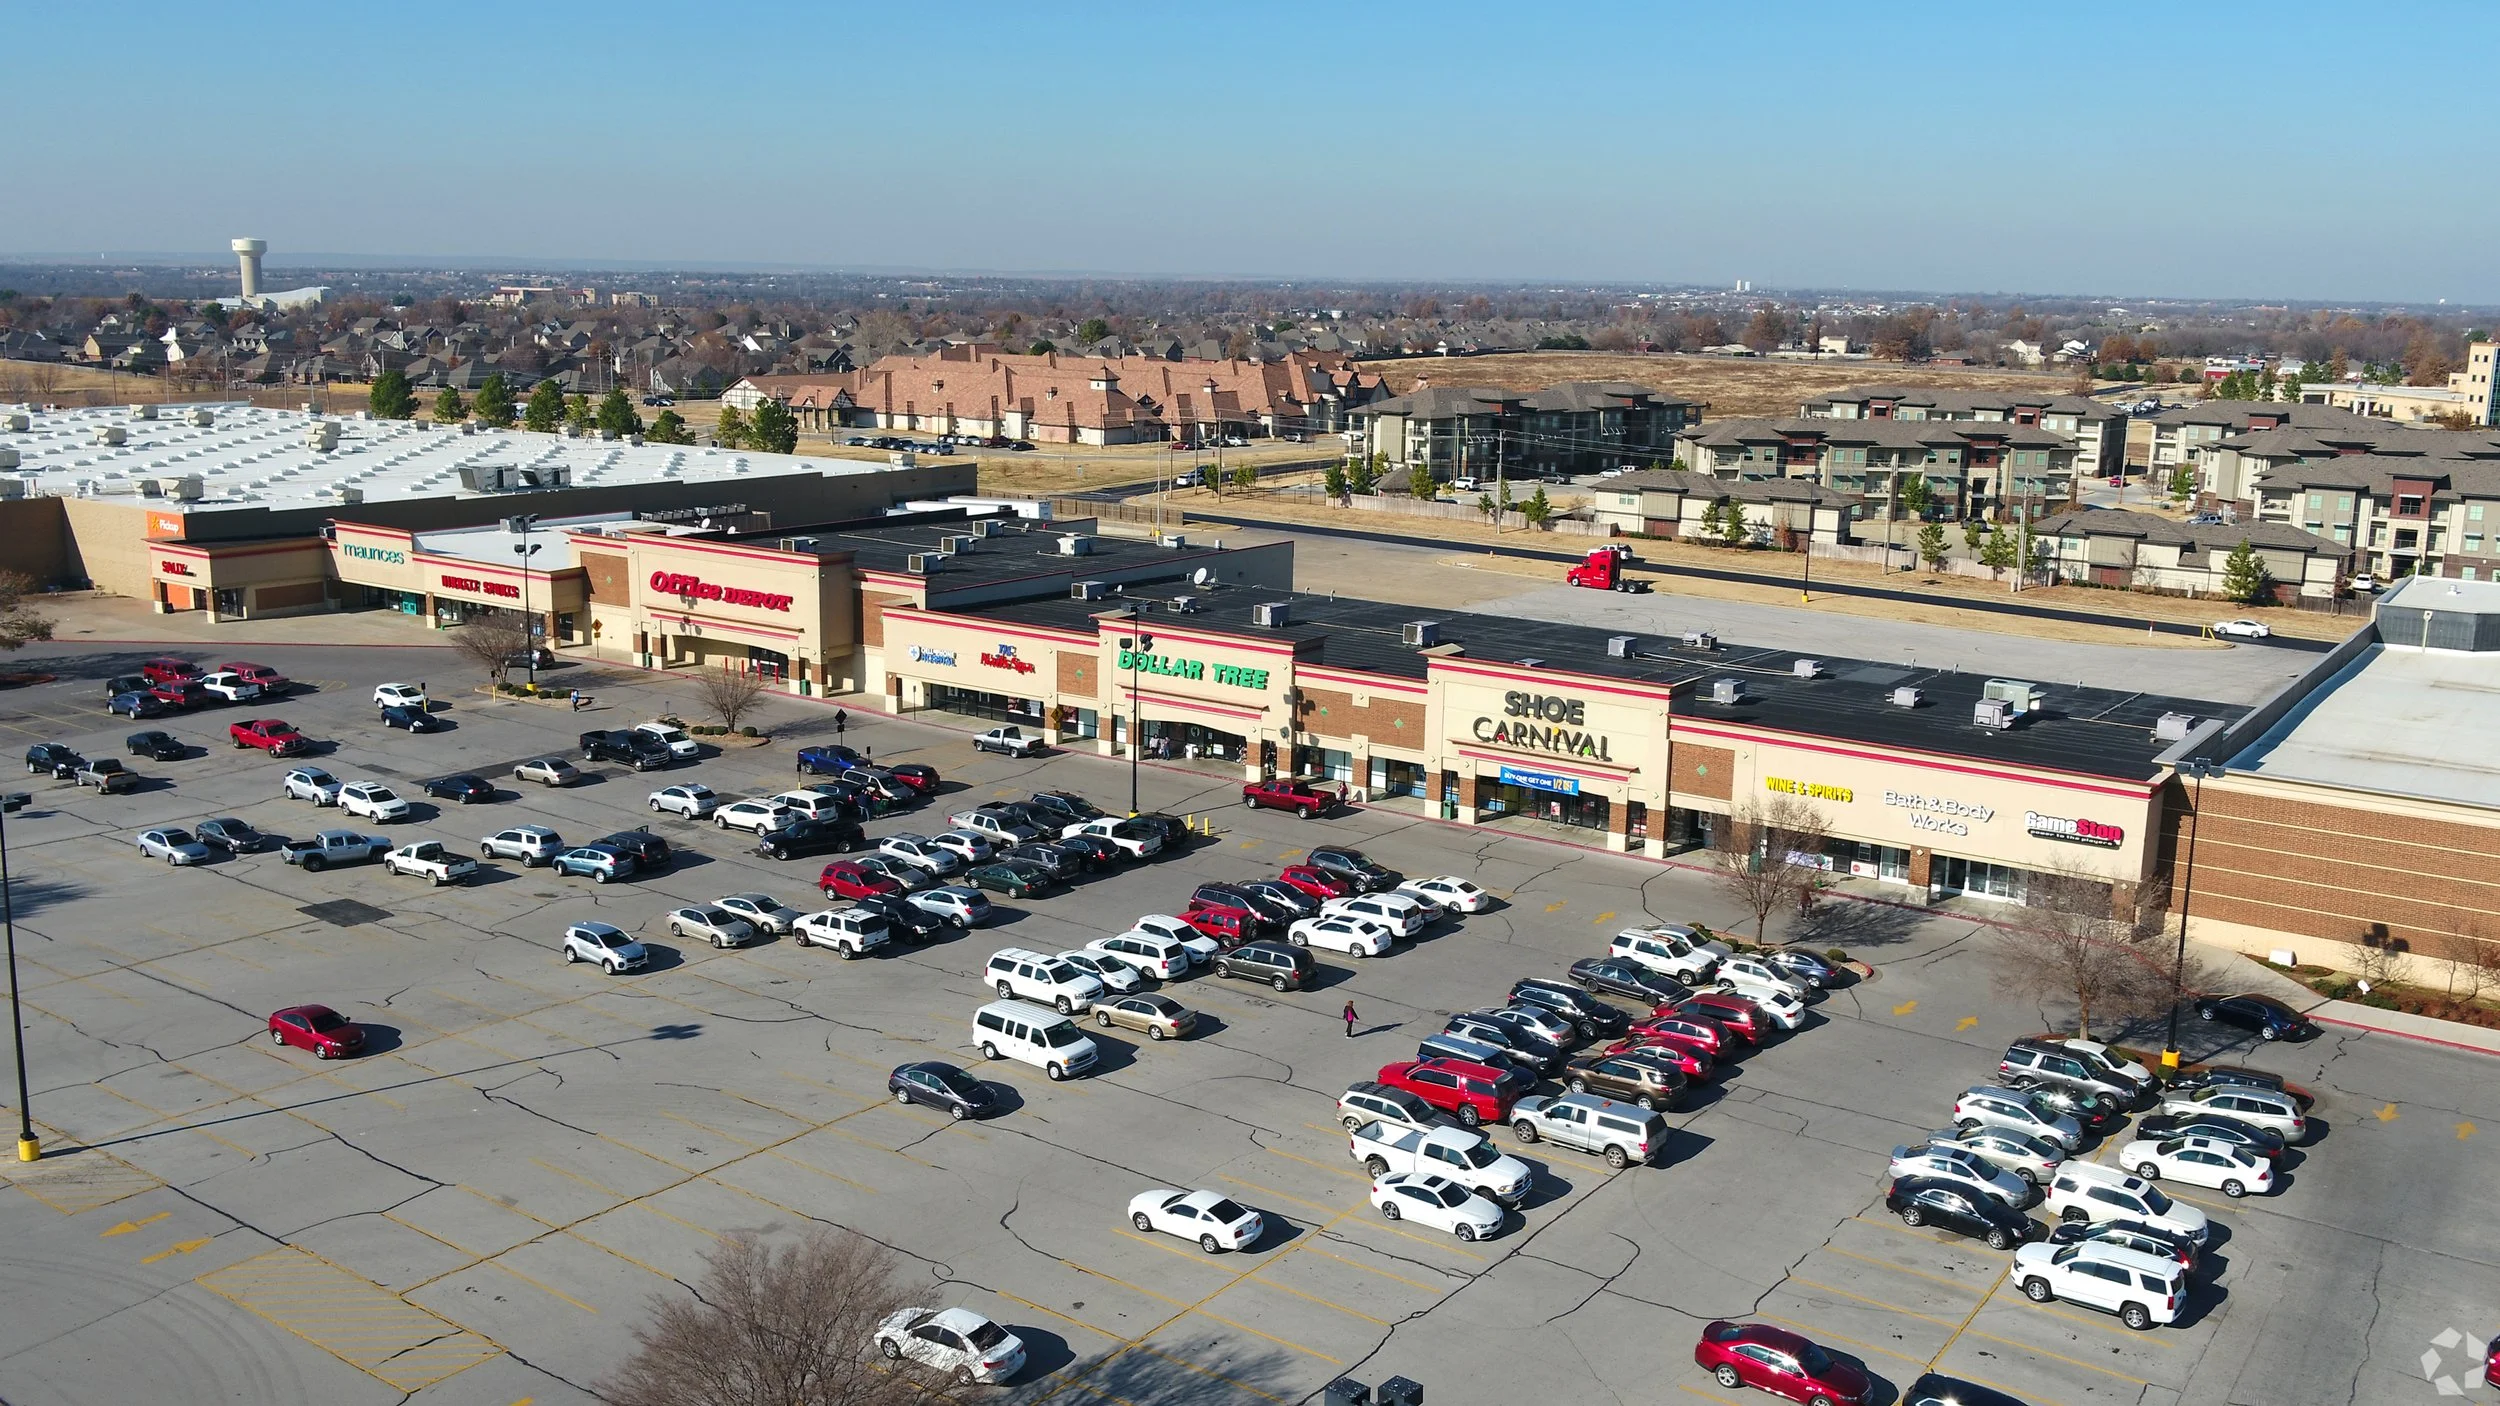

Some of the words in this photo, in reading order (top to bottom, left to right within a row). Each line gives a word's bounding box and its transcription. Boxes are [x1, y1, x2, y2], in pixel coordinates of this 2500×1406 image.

[160, 519, 179, 534] Pickup
[343, 543, 405, 564] maurices
[483, 581, 520, 599] SPORTS
[650, 571, 722, 601] Office
[722, 587, 793, 612] DEPOT
[1118, 650, 1204, 680] DOLLAR
[1212, 663, 1269, 690] TREE
[1503, 690, 1585, 726] SHOE
[1473, 717, 1612, 762] CARNIVAL
[1504, 772, 1515, 780] BUY
[1515, 774, 1527, 782] ONE
[1553, 778, 1562, 790] 1/2
[1765, 776, 1795, 793] WINE
[1797, 781, 1807, 795] &
[1808, 783, 1853, 802] SPIRITS
[1884, 790, 1927, 811] Bath
[1928, 797, 1944, 813] &
[1945, 799, 1995, 822] Body
[1908, 812, 1968, 836] Works
[2024, 810, 2124, 843] GameStop
[2081, 836, 2113, 846] players
